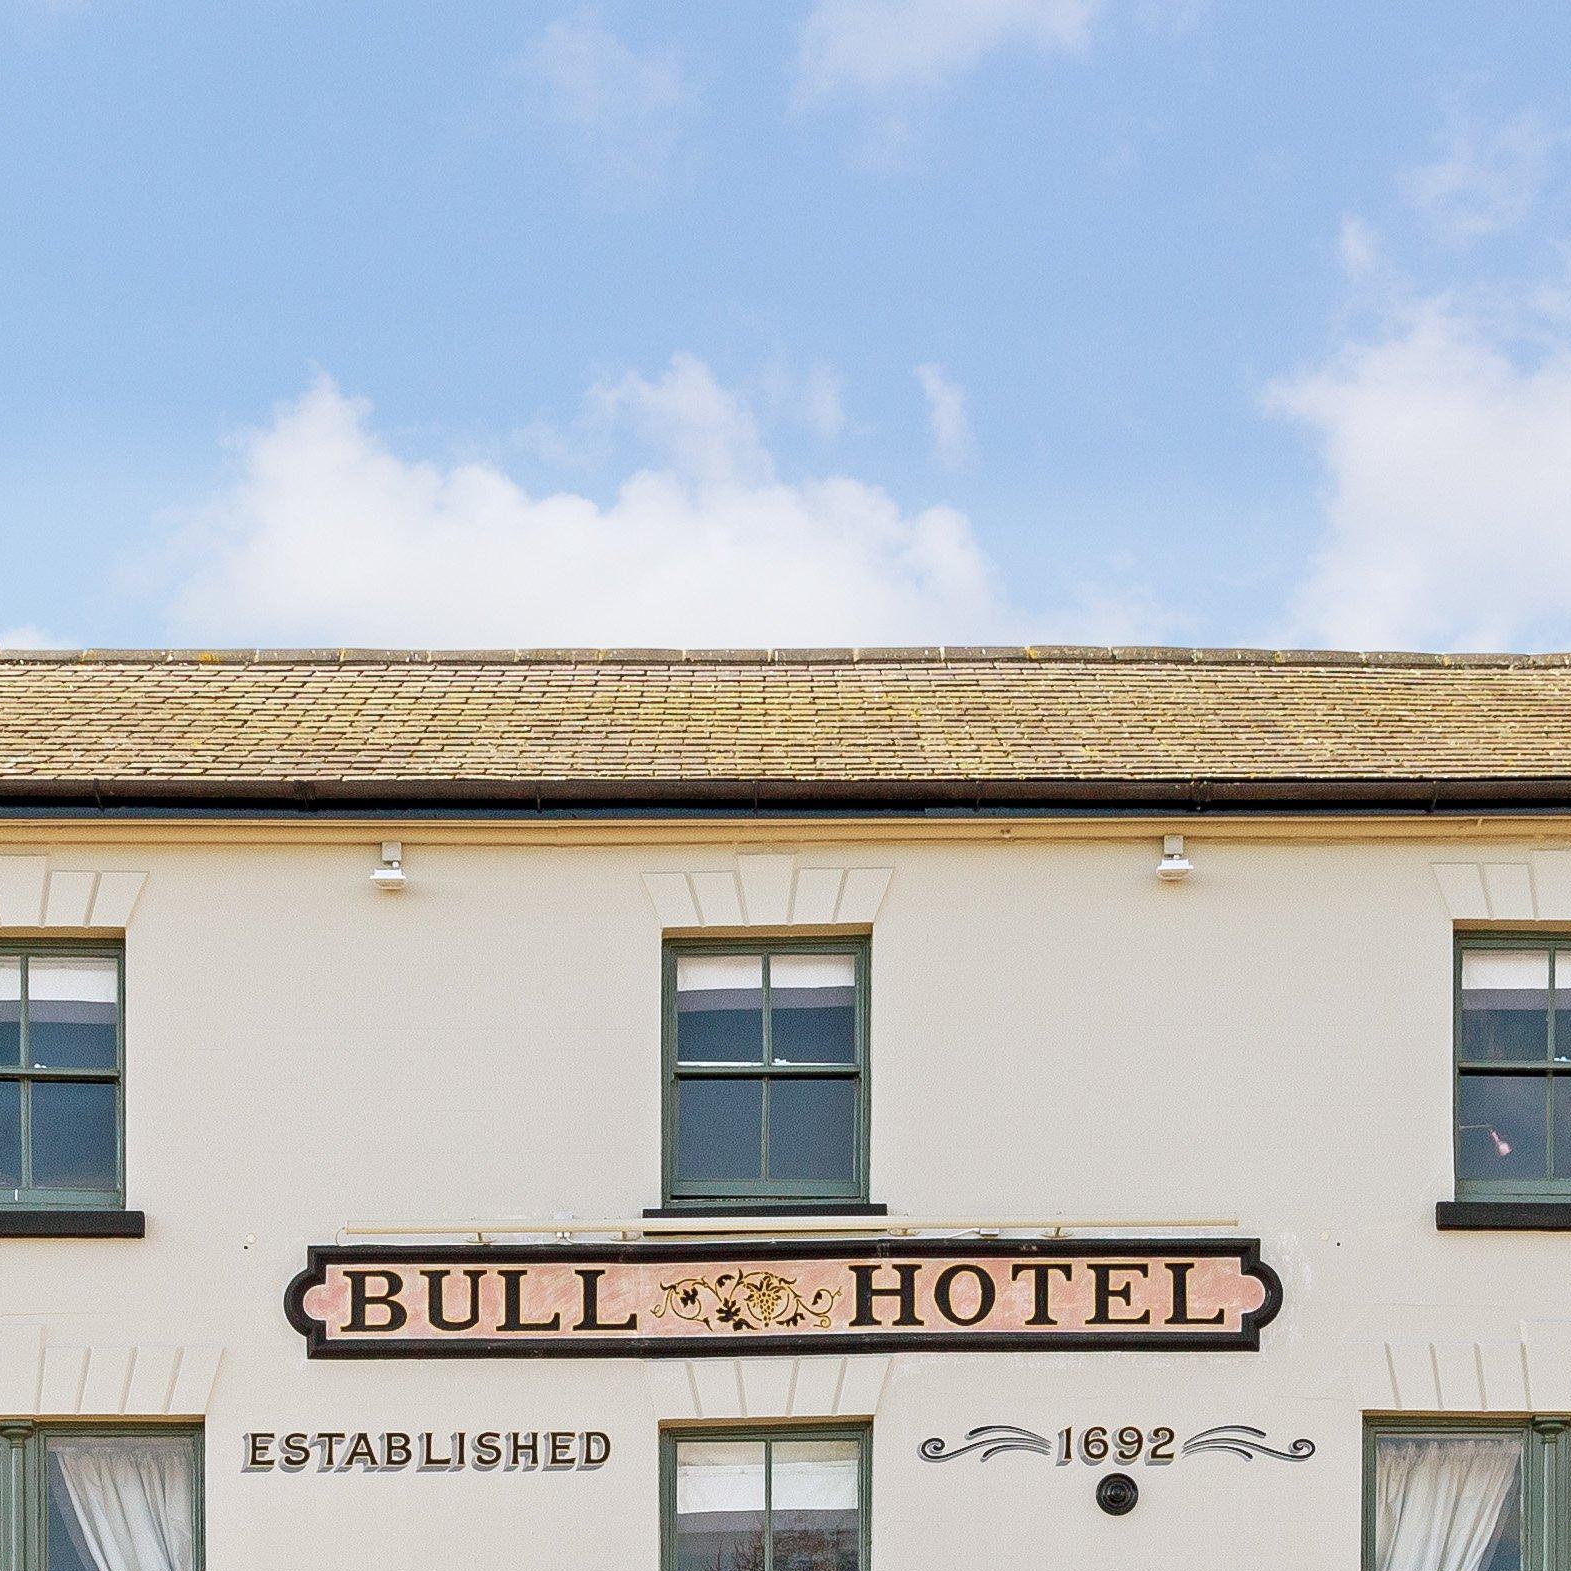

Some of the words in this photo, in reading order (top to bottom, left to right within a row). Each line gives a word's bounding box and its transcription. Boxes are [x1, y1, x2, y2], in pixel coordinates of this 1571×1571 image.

[340, 1269, 638, 1333] BULL
[848, 1262, 1225, 1327] HOTEL
[242, 1431, 612, 1471] ESTABLISHED
[1058, 1425, 1176, 1464] 1692
